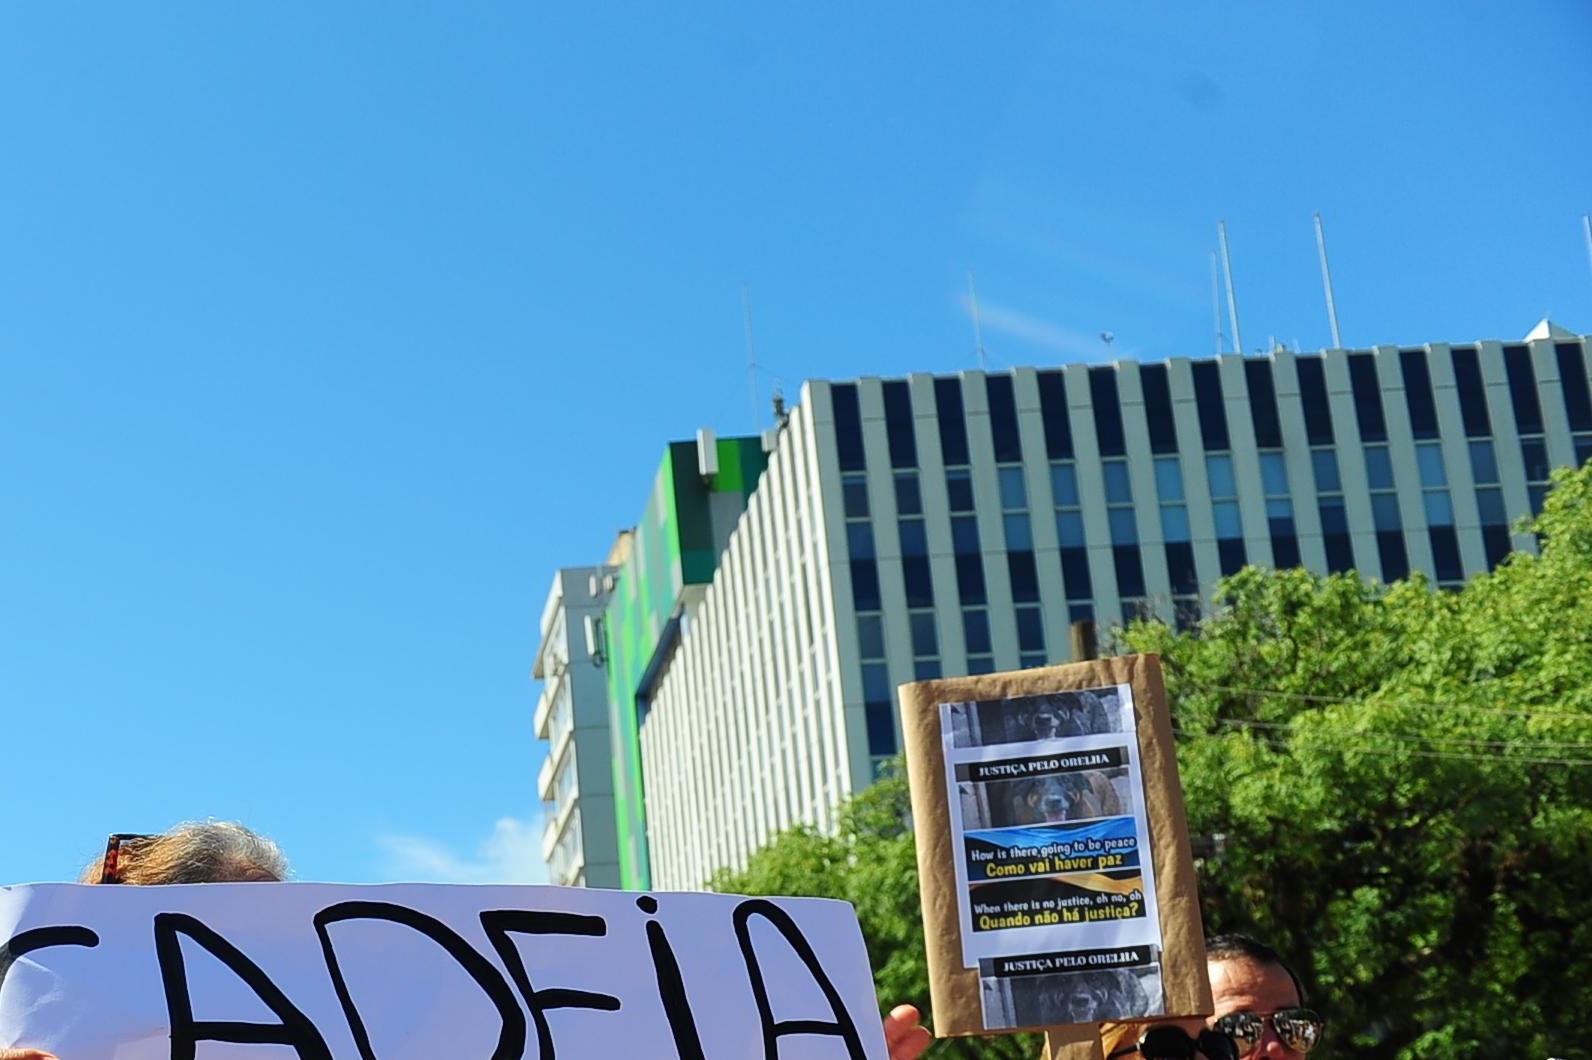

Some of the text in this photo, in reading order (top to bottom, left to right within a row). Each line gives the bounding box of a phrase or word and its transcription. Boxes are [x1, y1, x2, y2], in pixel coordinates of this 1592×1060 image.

[979, 753, 1110, 777] JUSTIÇA PELO ORELHA
[971, 850, 994, 861] How
[997, 848, 1007, 859] is
[1040, 843, 1070, 858] going
[1074, 842, 1085, 851] to
[1088, 839, 1101, 850] be
[1104, 837, 1135, 850] peace
[986, 855, 1123, 877] Como vai haver paz
[974, 891, 1141, 915] When there is no justice, oh no, oh
[979, 902, 1139, 930] Quando não há justiça?
[1003, 951, 1139, 972] JUSTIÇA PELO ORELHA
